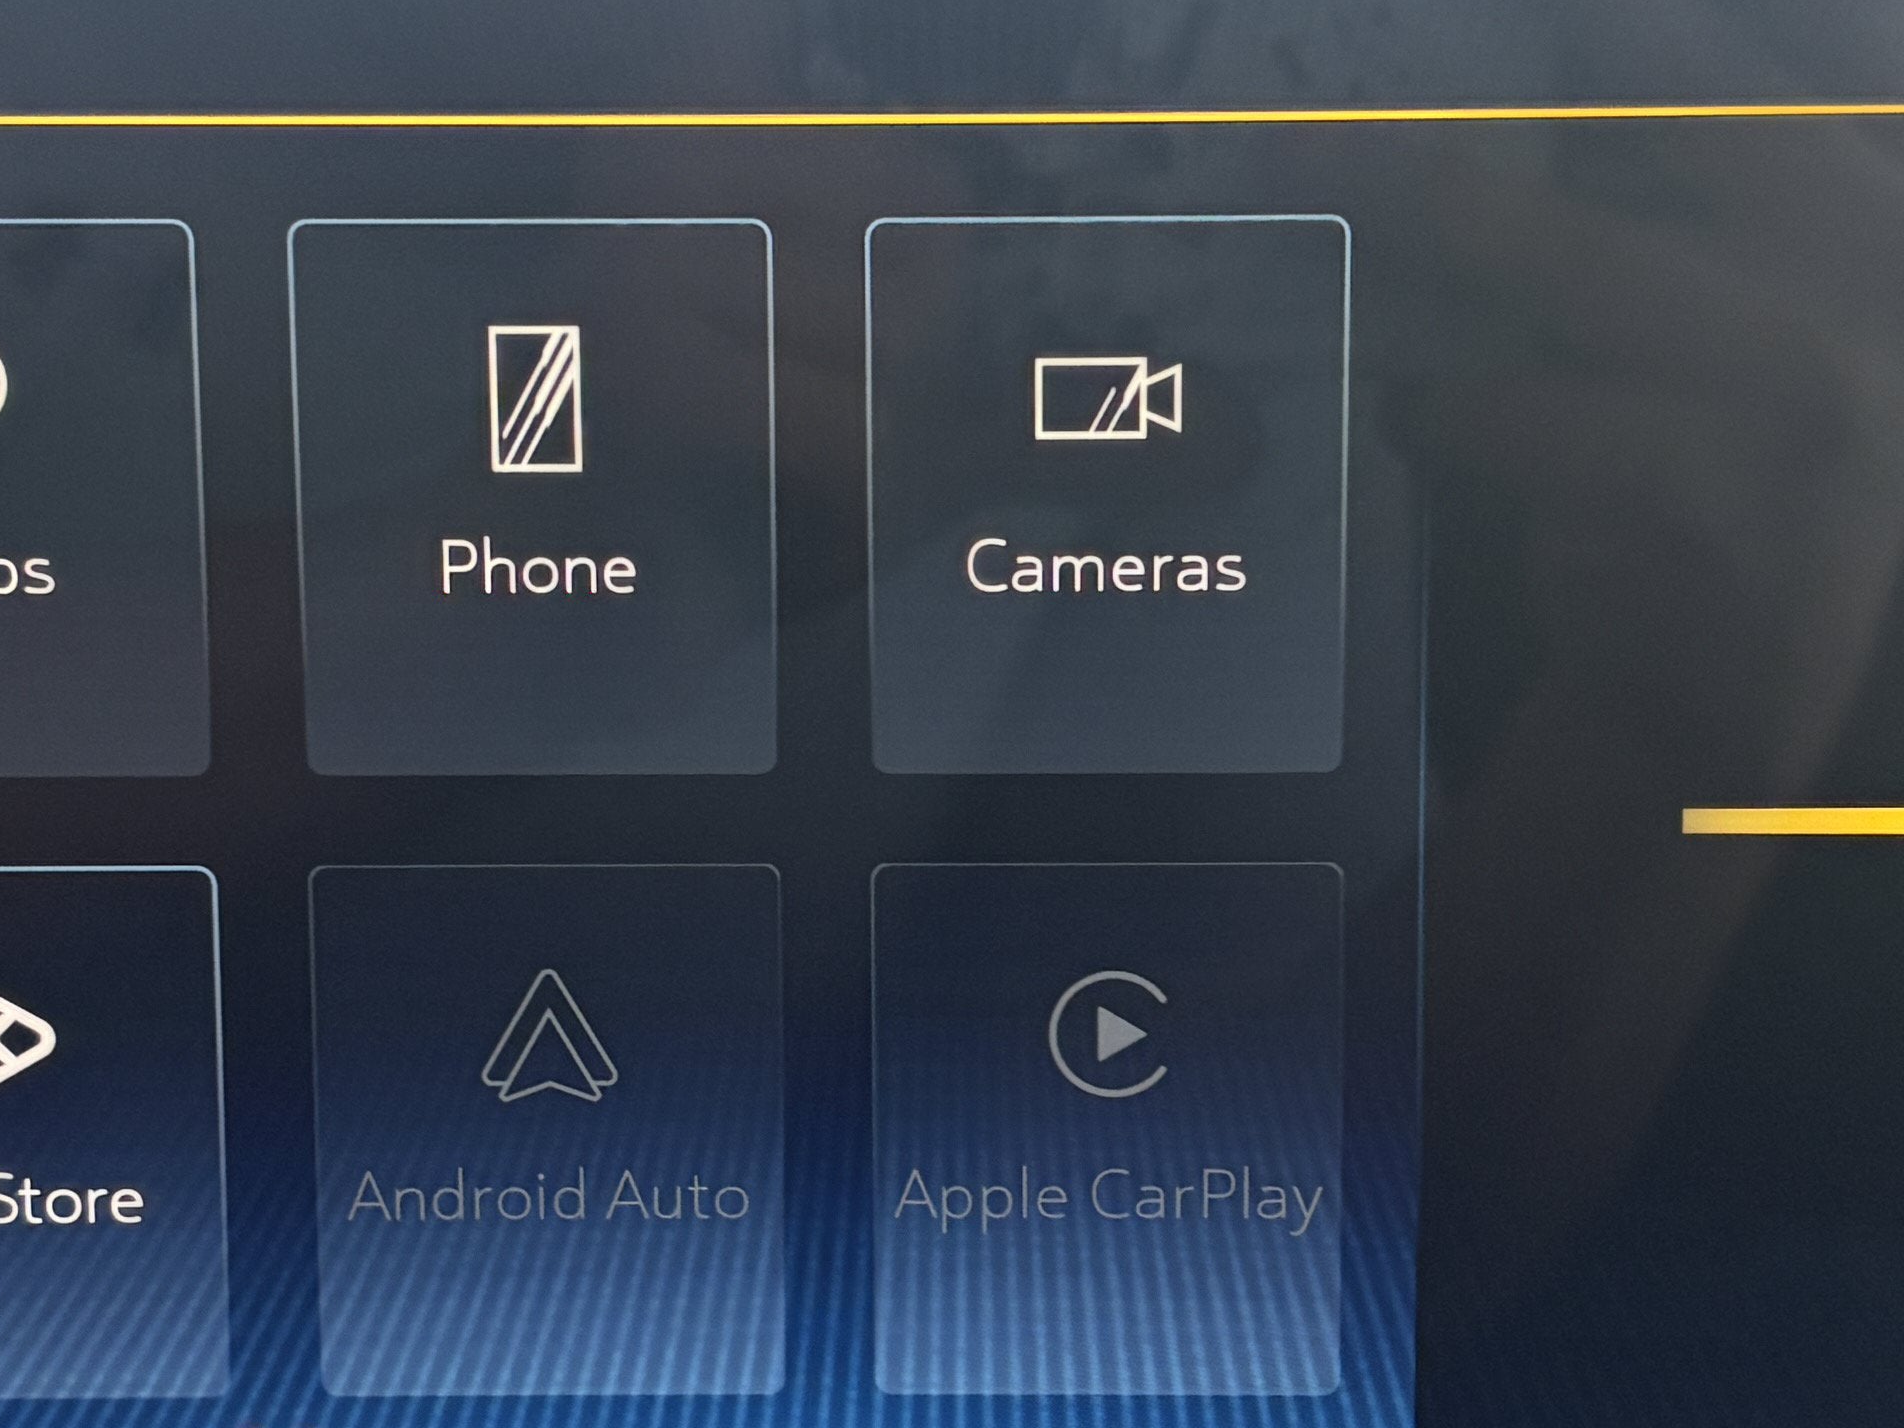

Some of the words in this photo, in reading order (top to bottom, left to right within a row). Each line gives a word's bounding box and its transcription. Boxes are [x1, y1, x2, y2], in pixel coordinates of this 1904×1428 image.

[441, 535, 637, 594] Phone
[967, 537, 1247, 593] Cameras
[347, 1166, 586, 1222] Android
[605, 1169, 750, 1220] Auto
[895, 1165, 1068, 1234] Apple
[1091, 1165, 1324, 1237] CarPlay
